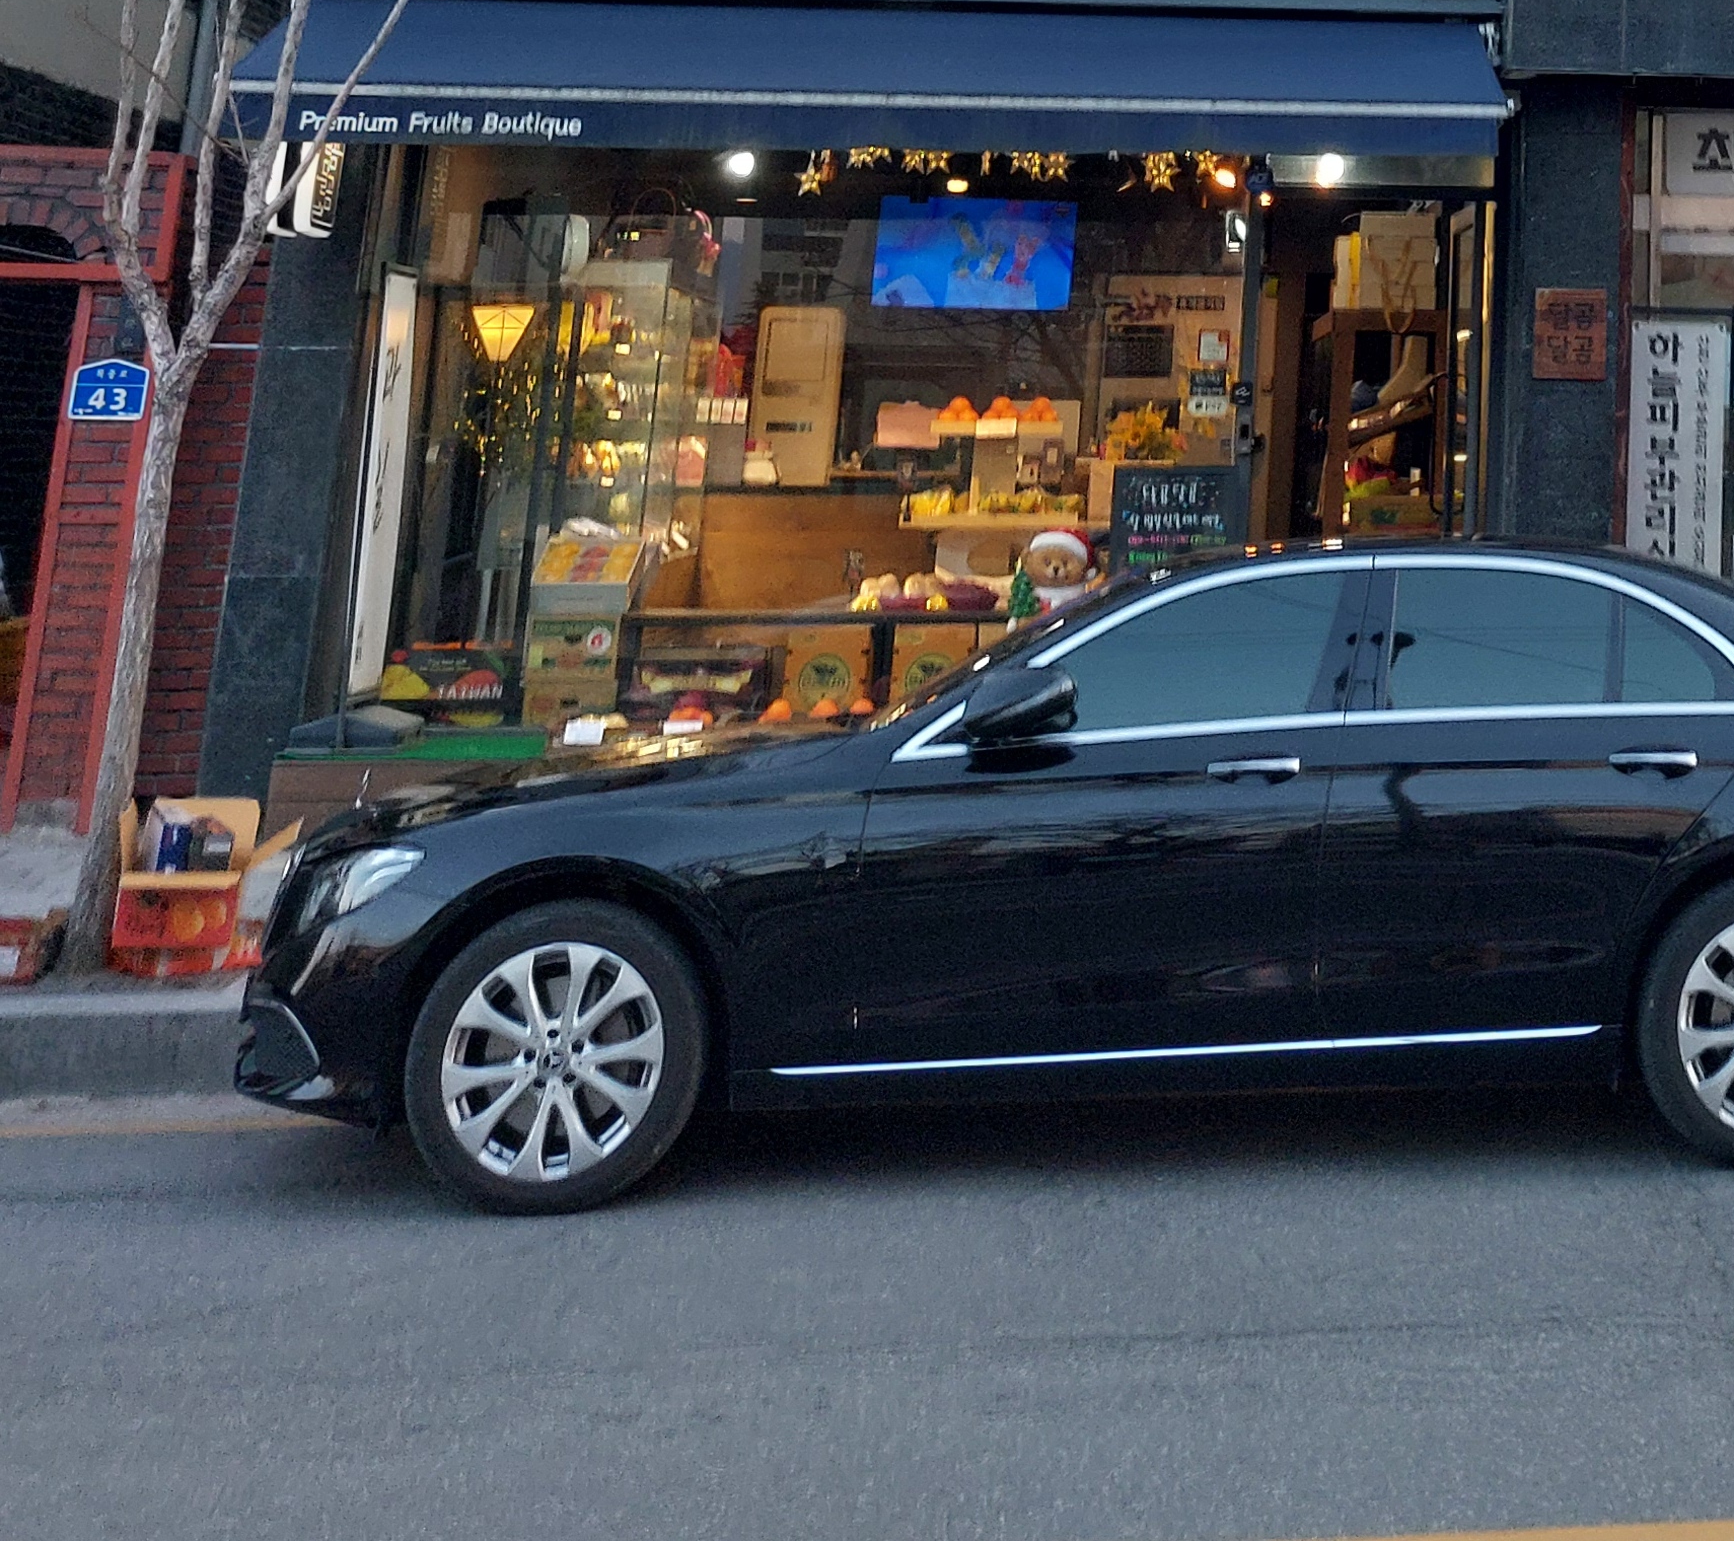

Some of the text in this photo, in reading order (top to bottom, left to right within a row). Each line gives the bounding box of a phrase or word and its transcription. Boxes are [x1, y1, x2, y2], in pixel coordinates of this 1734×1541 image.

[408, 110, 474, 135] Fruits
[481, 112, 584, 142] Boutique
[87, 387, 128, 411] 43
